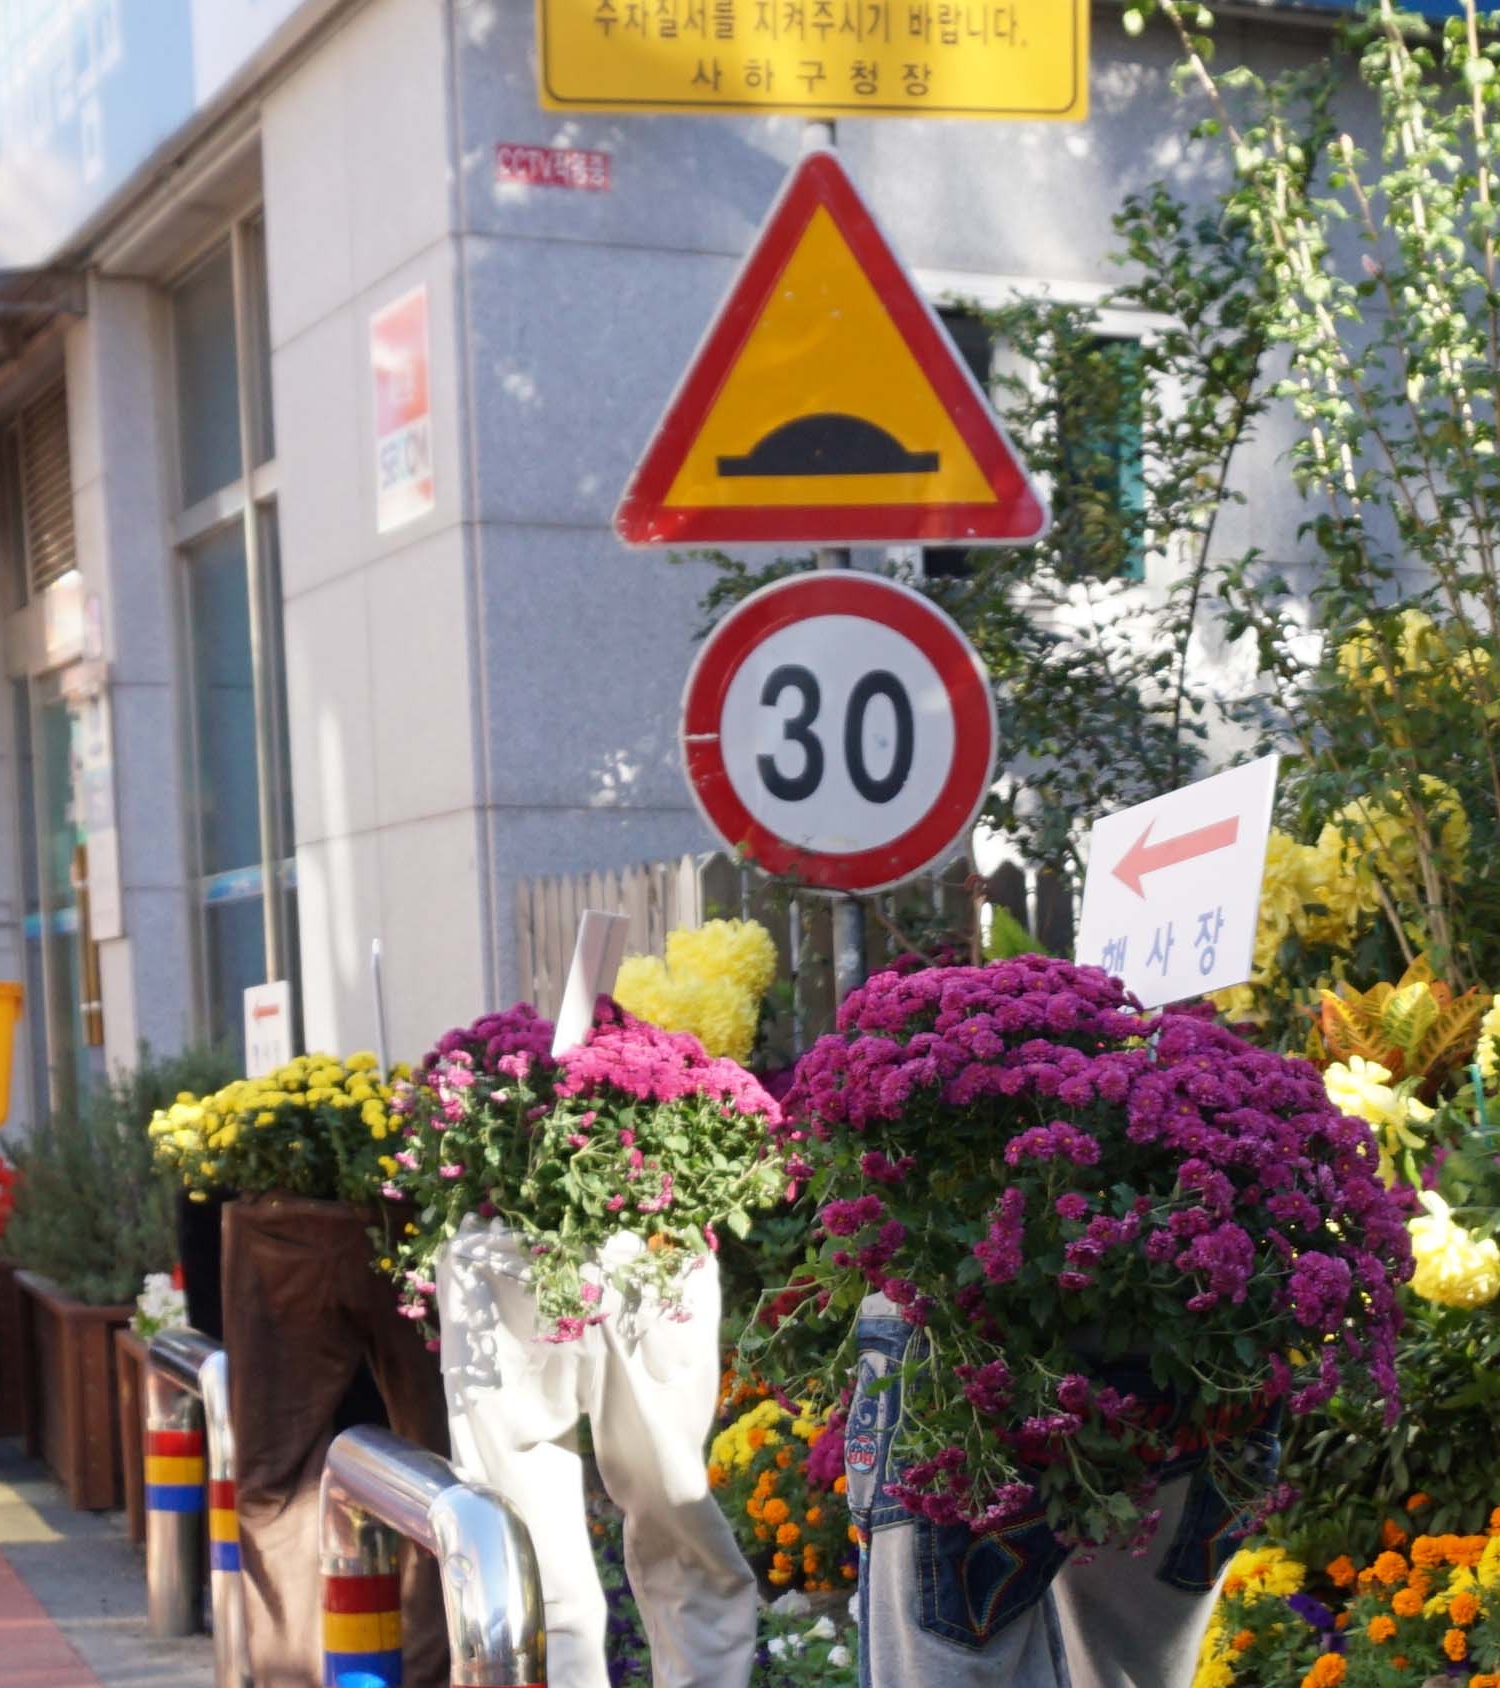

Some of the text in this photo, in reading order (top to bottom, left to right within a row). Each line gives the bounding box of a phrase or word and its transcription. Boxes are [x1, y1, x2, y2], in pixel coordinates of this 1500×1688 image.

[753, 0, 892, 43] 지켜주시기
[908, 3, 1029, 47] 바랍니다.
[757, 664, 915, 804] 30
